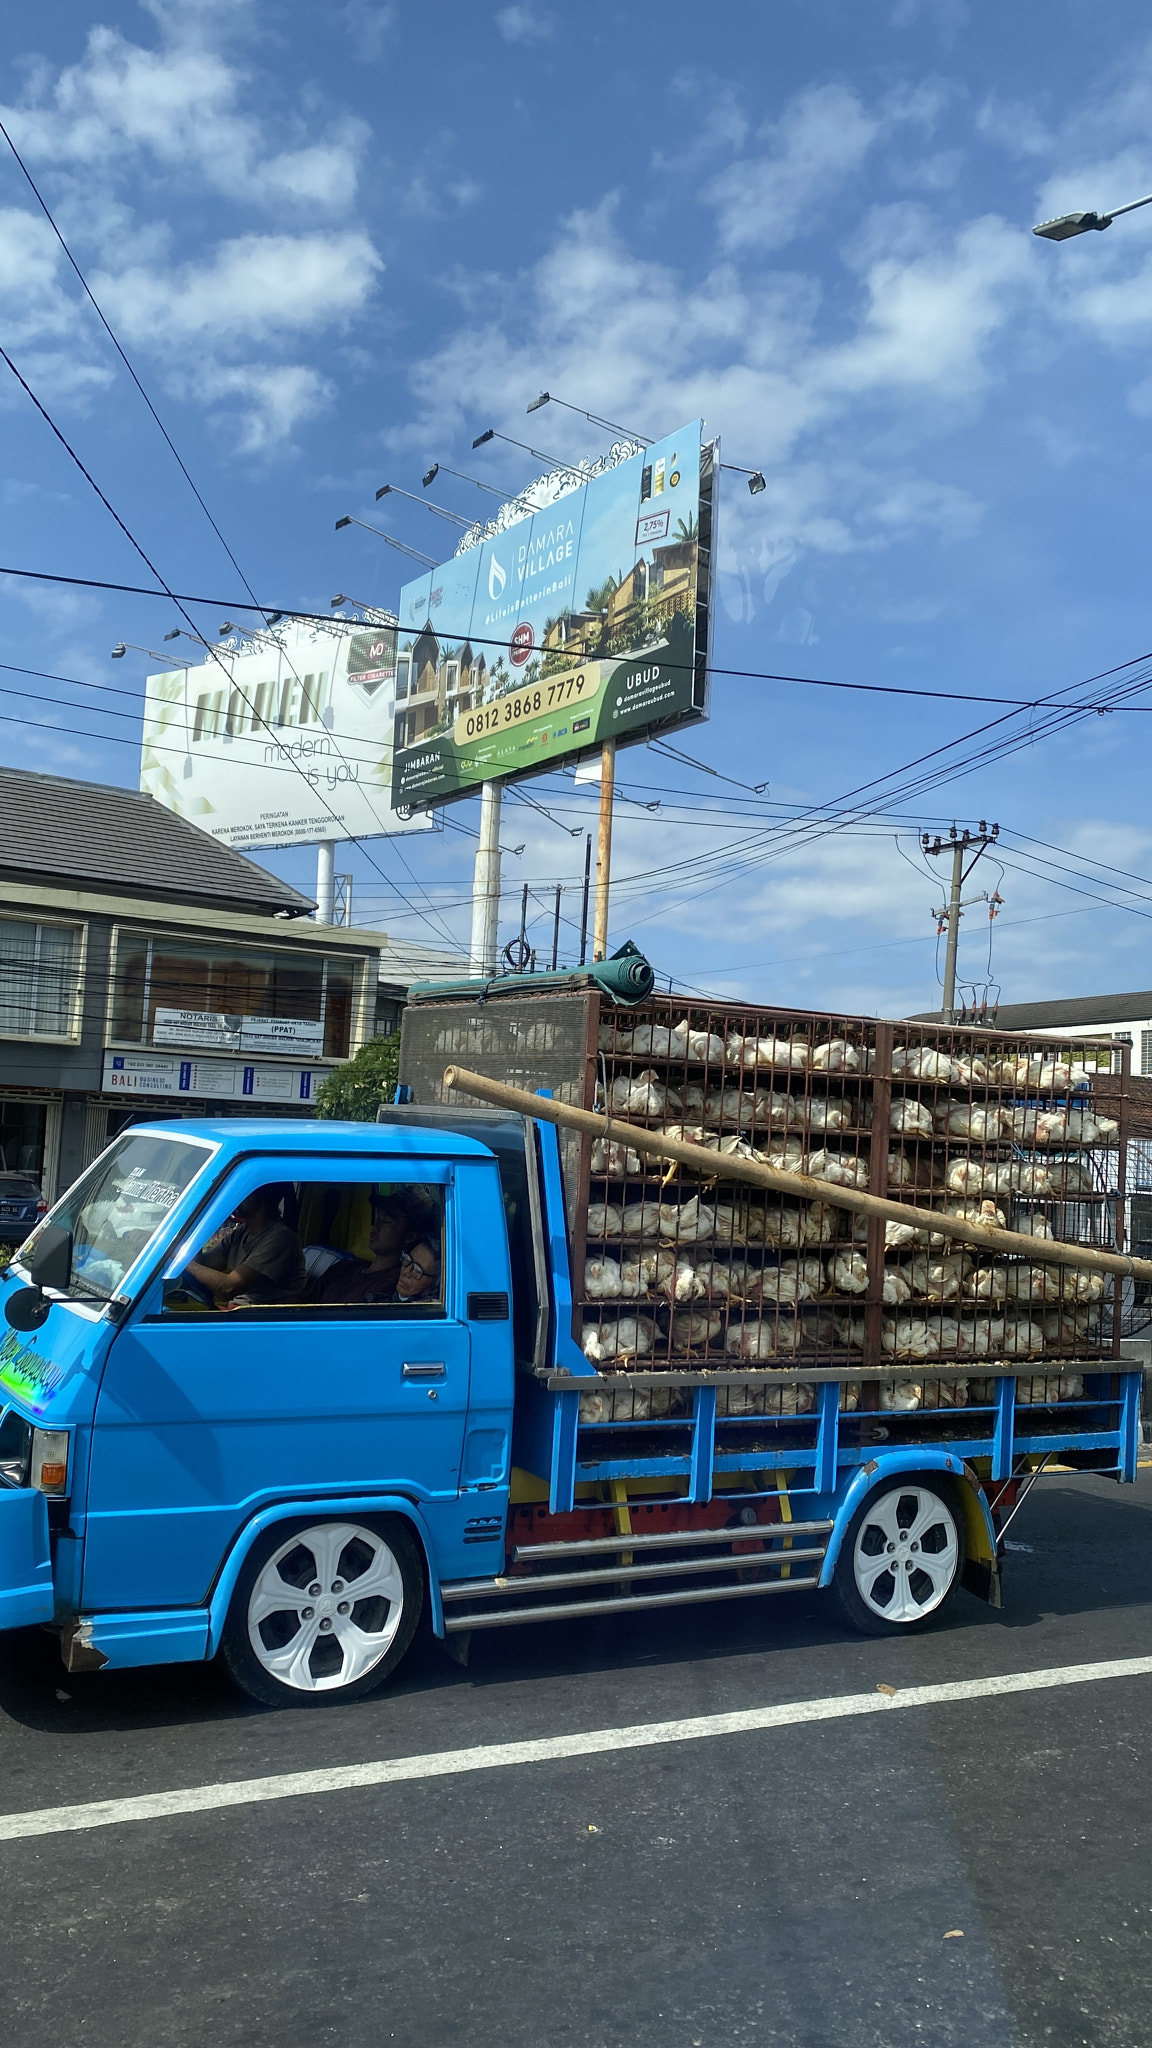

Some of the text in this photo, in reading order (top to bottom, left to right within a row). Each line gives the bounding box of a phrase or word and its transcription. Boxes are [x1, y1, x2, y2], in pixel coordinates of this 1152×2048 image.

[518, 520, 574, 563] DAMARA
[517, 540, 573, 582] VILLAGE
[485, 574, 571, 625] #LifeisBetterinBali
[350, 674, 366, 682] FILTER
[627, 666, 660, 690] UBUD
[466, 674, 585, 736] 0812 3868 7779
[264, 734, 331, 763] modern
[404, 751, 440, 773] JIMBARAN
[307, 764, 359, 791] is you
[212, 826, 230, 835] KARENA
[254, 822, 266, 830] SAYA
[266, 820, 288, 829] TERKENA
[288, 818, 308, 827] KANKER
[308, 815, 345, 825] TENGGOROKAN
[260, 811, 289, 820] PERINGATAN
[230, 834, 250, 842] LAYANAN
[250, 832, 271, 840] BERHENTI
[271, 830, 294, 839] MEROKOK
[180, 1012, 218, 1022] NOTARIS
[271, 1026, 296, 1035] (PPAT)
[111, 1074, 137, 1087] BALI
